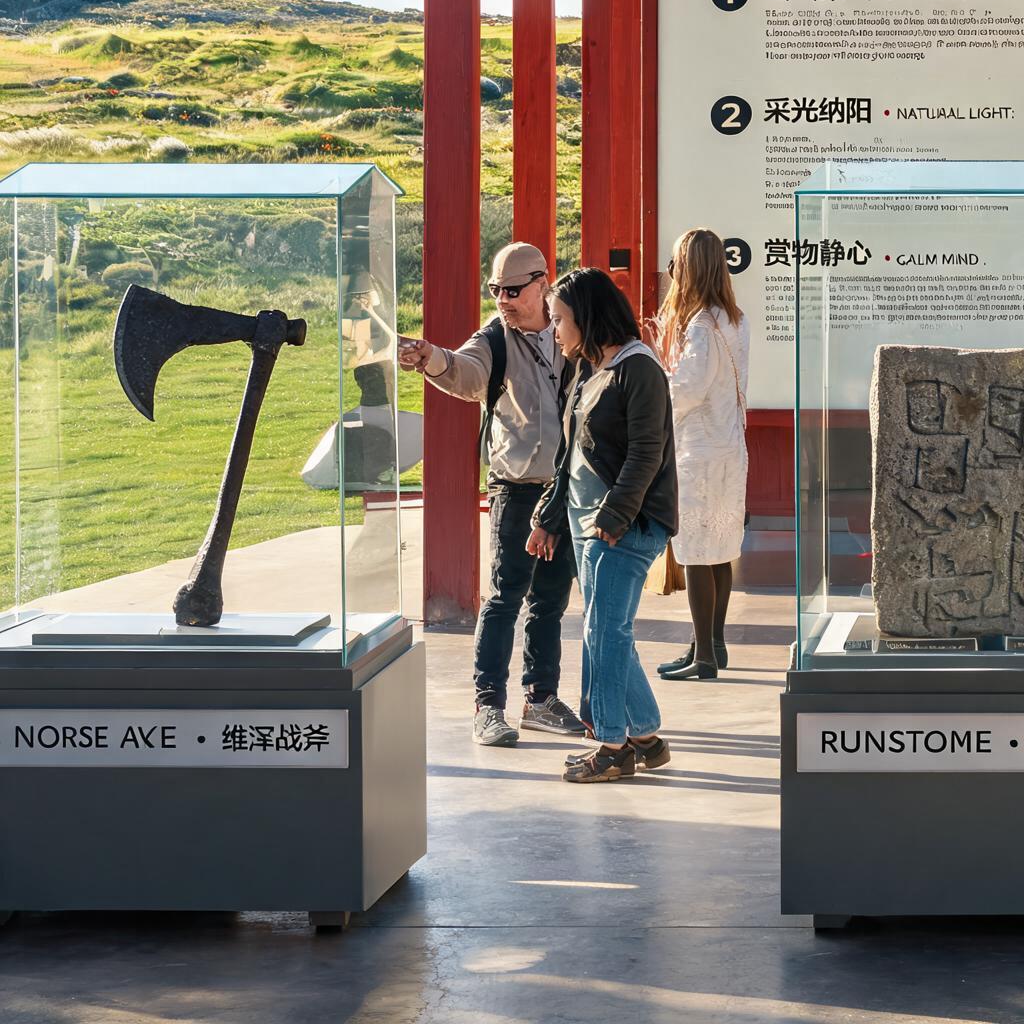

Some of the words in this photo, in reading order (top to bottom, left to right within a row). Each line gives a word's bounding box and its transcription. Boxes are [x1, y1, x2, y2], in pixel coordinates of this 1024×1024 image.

[721, 102, 742, 128] 2
[764, 97, 872, 124] 采光纳阳
[725, 245, 742, 266] 3
[764, 238, 873, 267] 赏物静心
[15, 725, 109, 749] NORSE
[821, 731, 992, 754] RUNSTOME
